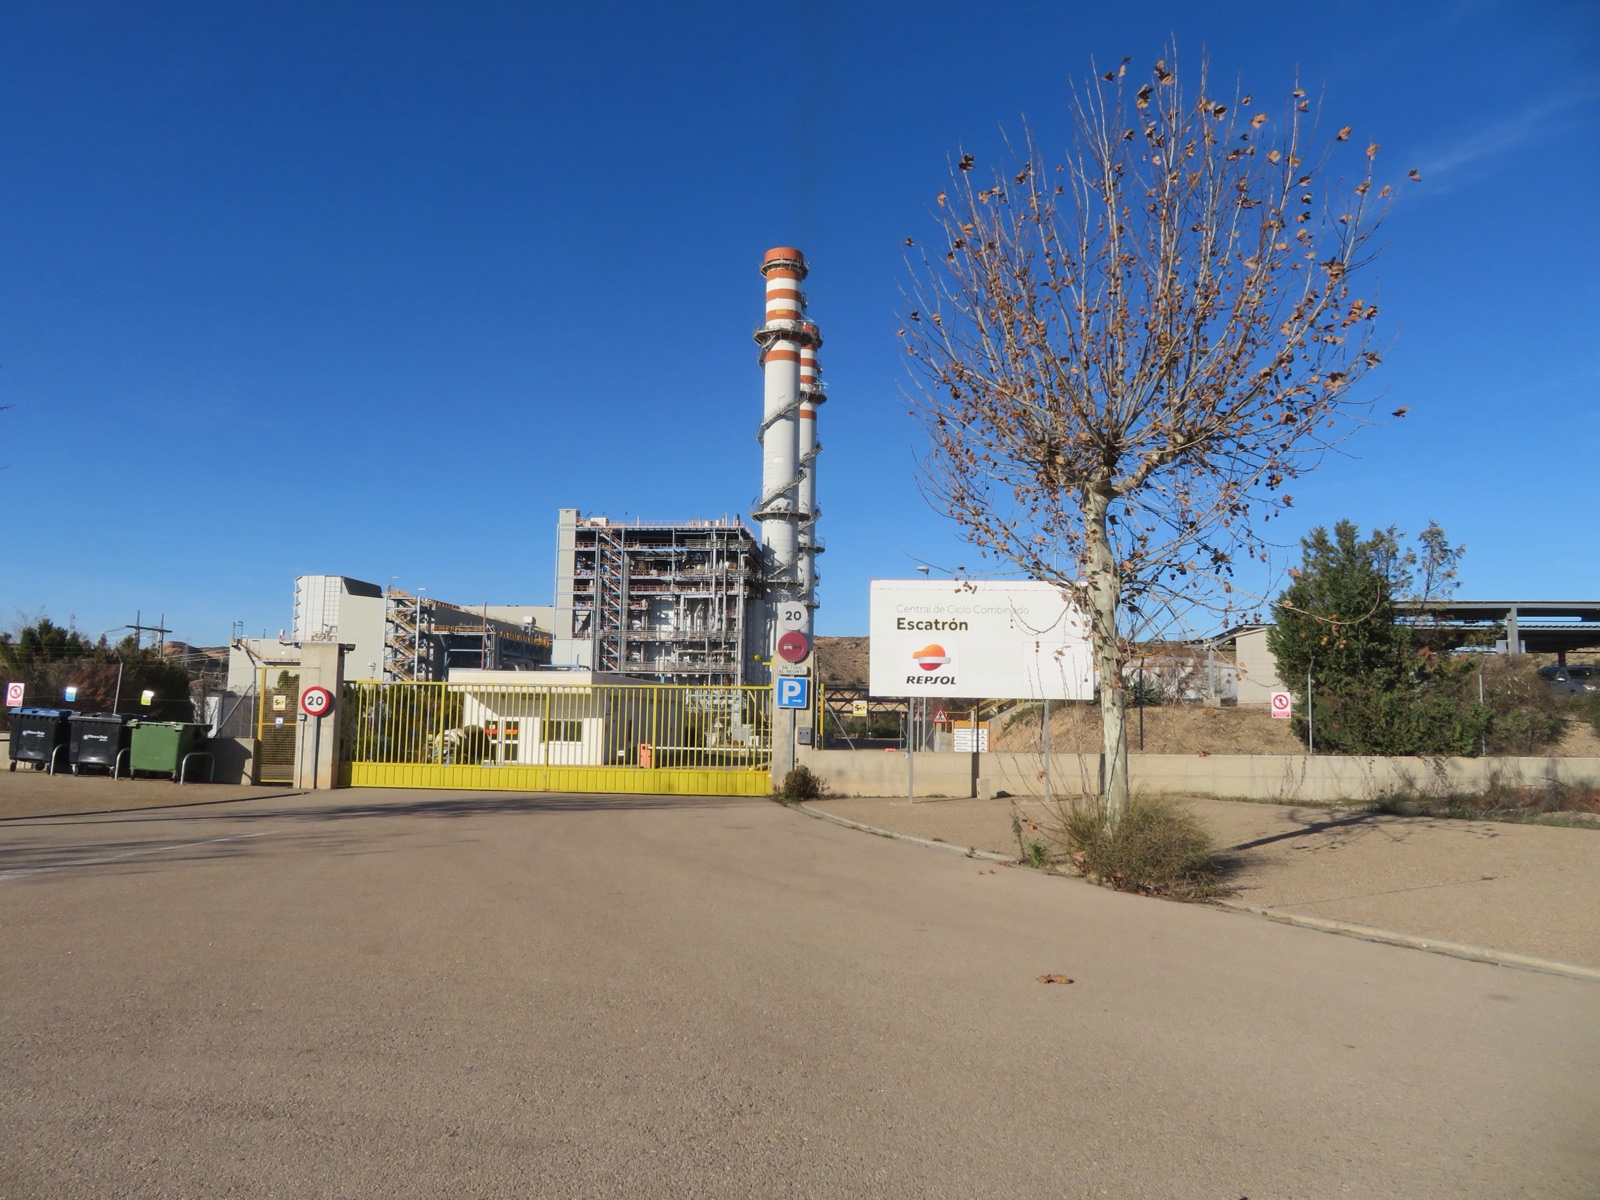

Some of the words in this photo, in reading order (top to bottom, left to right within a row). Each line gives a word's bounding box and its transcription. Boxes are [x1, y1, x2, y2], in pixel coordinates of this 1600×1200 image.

[896, 604, 931, 614] Central
[933, 604, 945, 614] de
[947, 605, 971, 615] Ciclo
[785, 610, 802, 621] 20
[896, 617, 969, 631] Escatrón
[906, 676, 956, 685] REPSOL
[782, 680, 802, 705] P
[307, 696, 324, 706] 20
